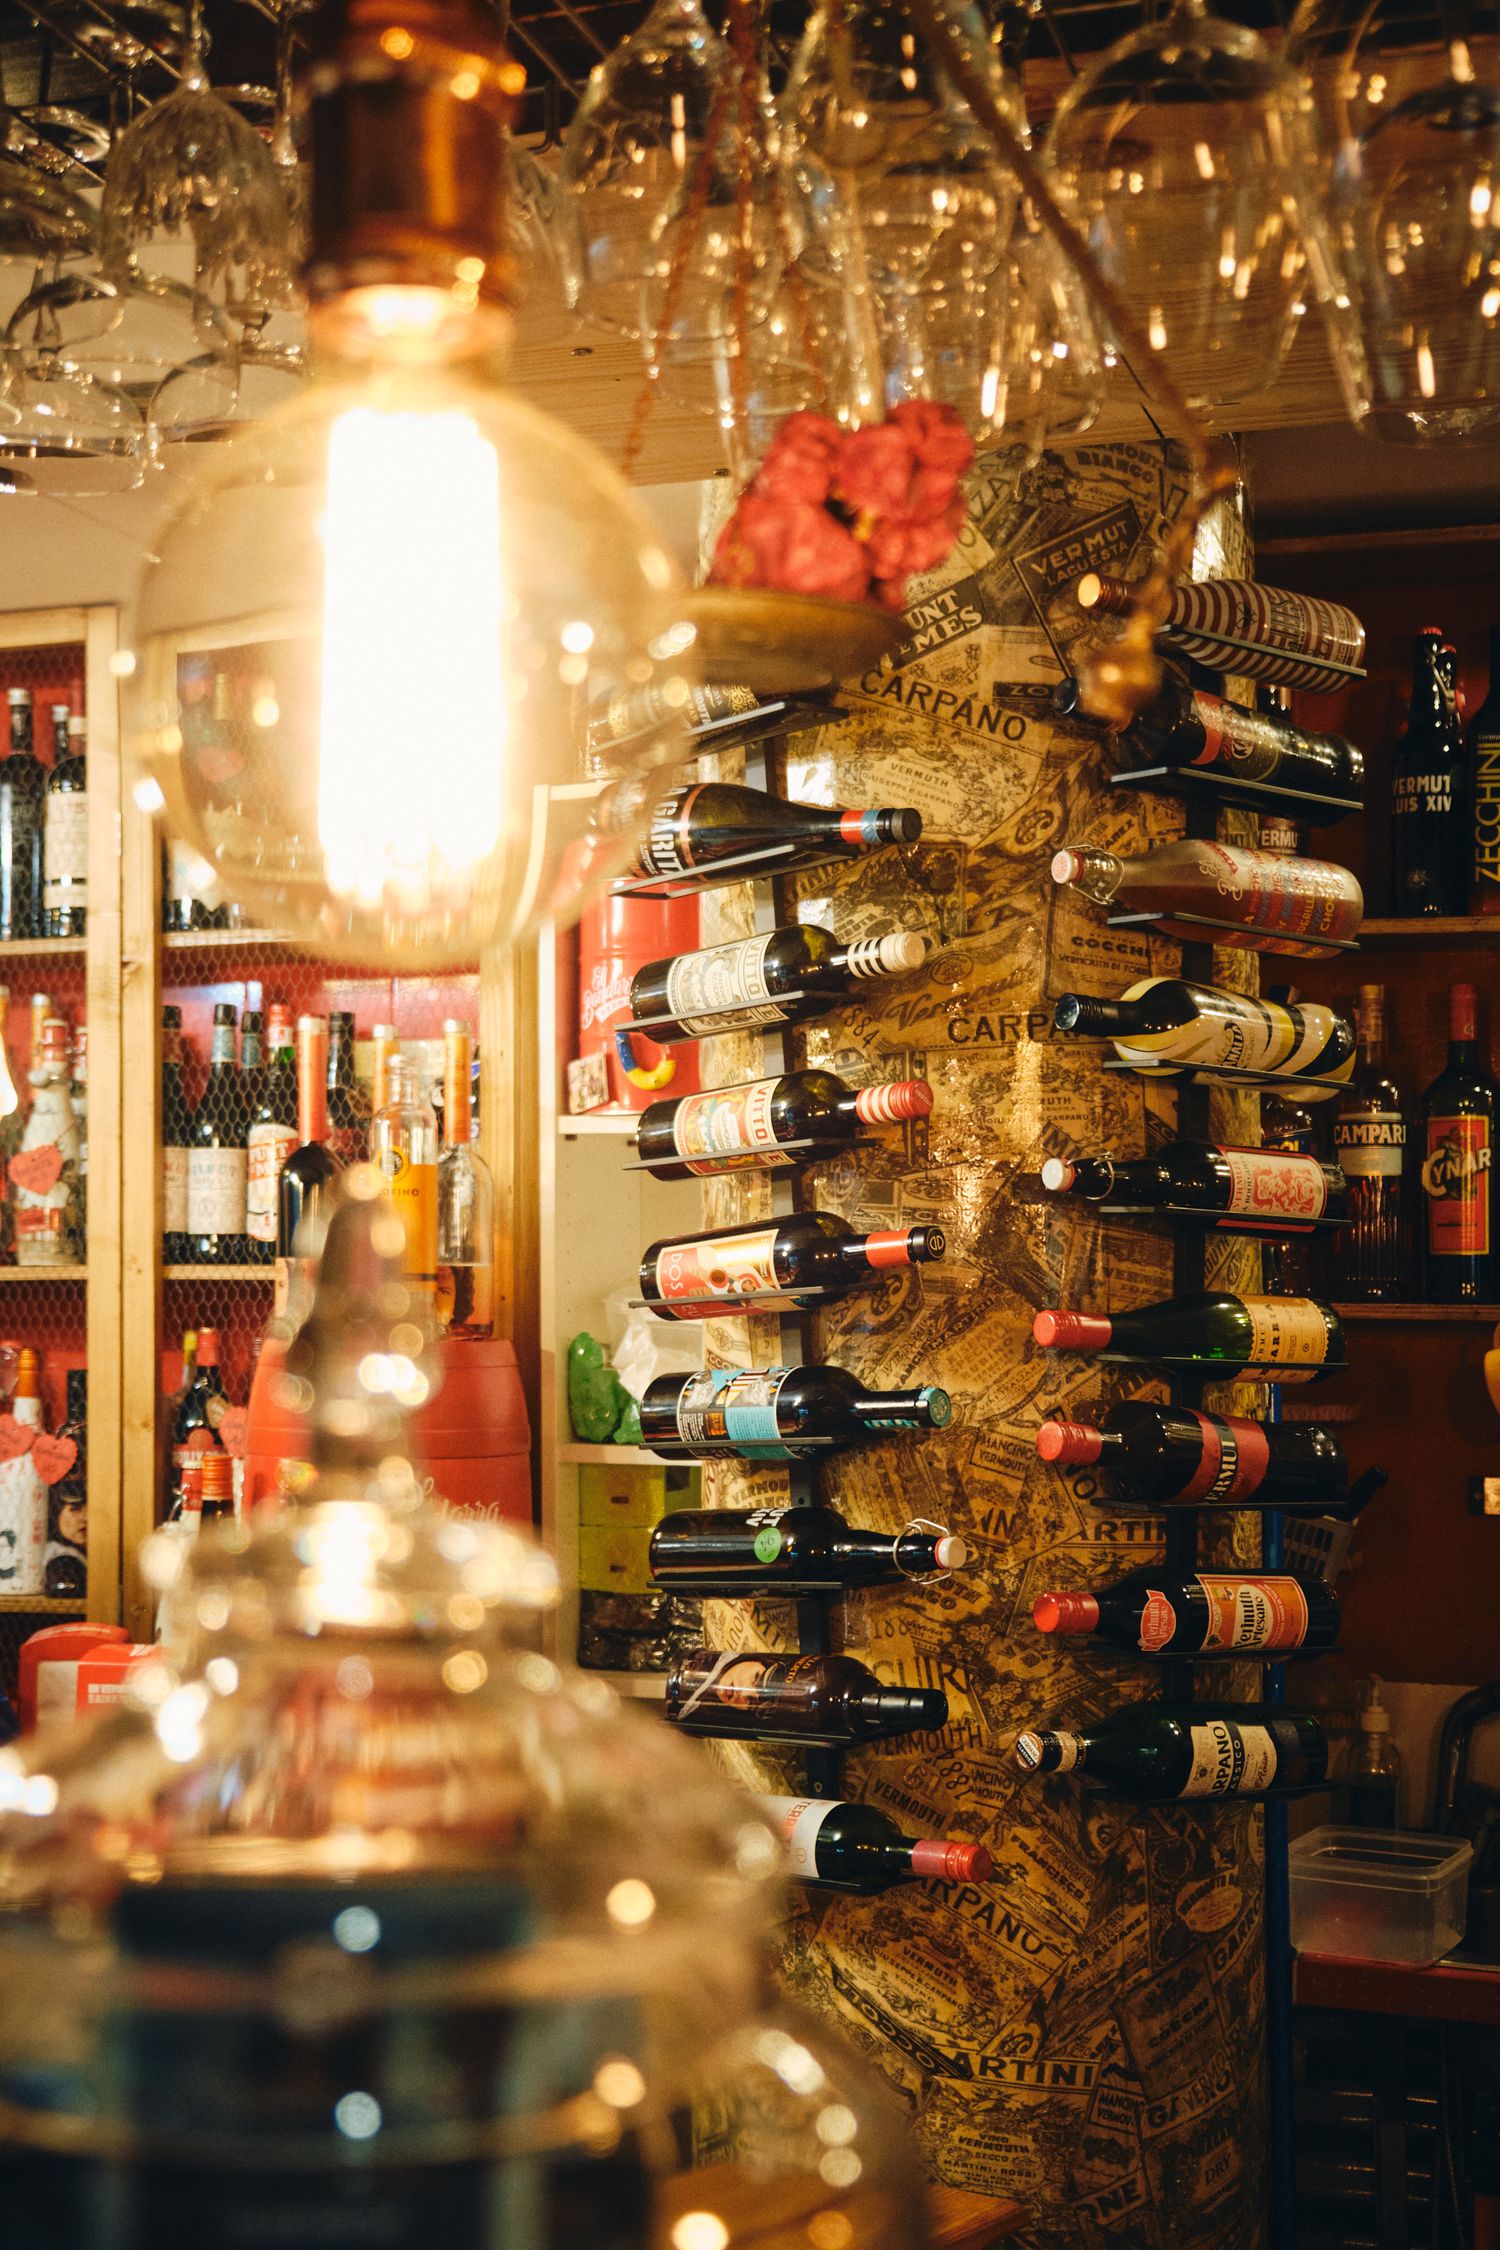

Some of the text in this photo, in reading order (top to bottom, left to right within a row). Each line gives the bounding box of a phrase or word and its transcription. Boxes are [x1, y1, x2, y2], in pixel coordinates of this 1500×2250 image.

[1031, 520, 1128, 575] VERMUT
[1044, 542, 1129, 586] LACUESTA
[903, 590, 960, 631] UNT
[912, 605, 983, 653] MES
[860, 671, 1027, 741] CARPANO
[1008, 685, 1050, 697] ZO
[1392, 775, 1452, 793] VERMUT
[1426, 796, 1452, 812] XIV
[1475, 743, 1500, 883] ZECCHINI
[746, 943, 777, 1019] VITTOE
[1333, 1124, 1407, 1145] CAMPARI
[1421, 1147, 1492, 1197] CYNAR
[668, 1253, 684, 1291] DOS
[926, 1296, 996, 1350] MARTINI
[1205, 1441, 1237, 1500] ERMUT
[1233, 1590, 1251, 1649] Vermuth
[1212, 1726, 1231, 1793] RPANO
[872, 1779, 946, 1829] VERMOUTH
[926, 1878, 1045, 1956] RPANO
[953, 2052, 1094, 2088] ARTINI
[957, 2135, 1031, 2154] VERMOUTH
[974, 2152, 1009, 2163] SECCO
[979, 2132, 1009, 2144] VINO
[943, 2159, 993, 2174] MARTINI
[1204, 2152, 1233, 2185] DRY
